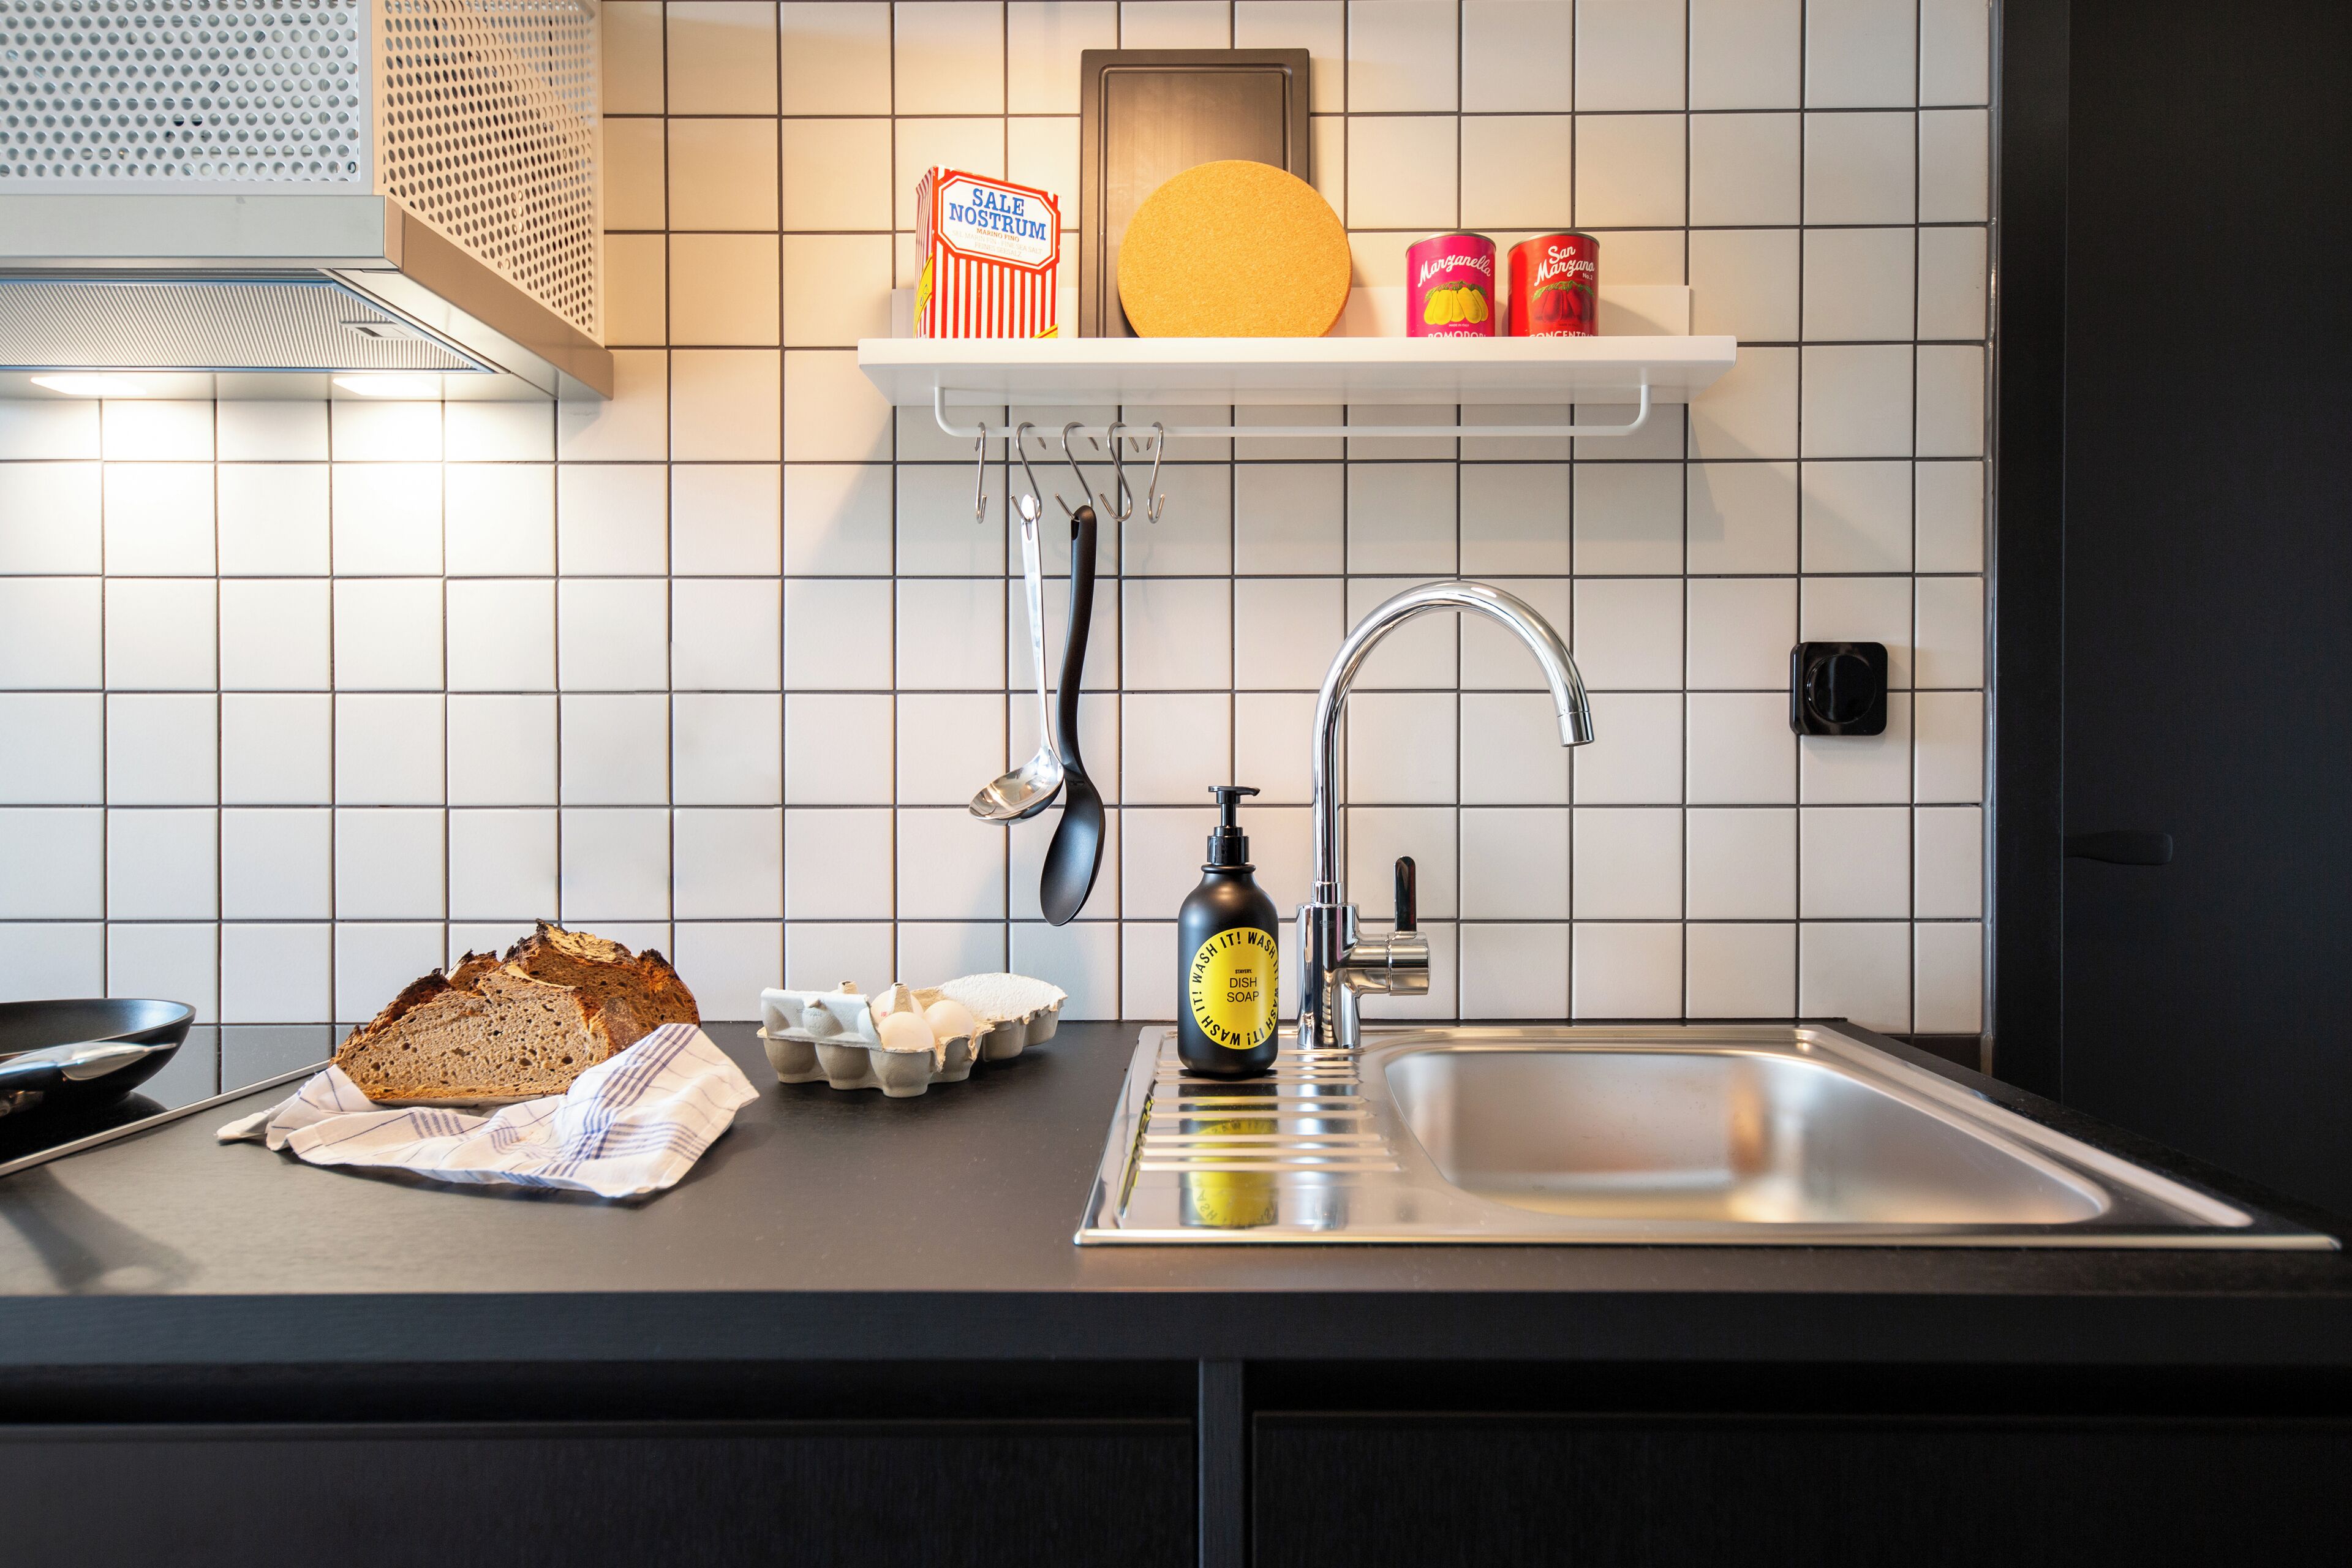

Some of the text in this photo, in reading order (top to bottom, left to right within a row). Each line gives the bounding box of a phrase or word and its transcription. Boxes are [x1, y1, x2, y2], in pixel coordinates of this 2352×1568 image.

[972, 187, 1024, 217] SALE
[949, 202, 1046, 241] NOSTRUM
[976, 228, 1020, 243] MARINO FINO
[1017, 243, 1027, 251] SEA
[1028, 246, 1042, 255] SALT
[1548, 245, 1576, 264] San
[1417, 254, 1491, 287] Marzanella
[1534, 259, 1595, 287] Marzano
[1582, 272, 1593, 281] No.2
[1219, 931, 1241, 948] IT!
[1248, 931, 1276, 959] WASH
[1192, 943, 1218, 983] WASH
[1229, 977, 1257, 988] DISH
[1192, 991, 1205, 1012] IT!
[1226, 991, 1259, 1003] SOAP
[1265, 987, 1278, 1031] WASH
[1201, 1015, 1240, 1046] WASH
[1246, 1028, 1265, 1046] IT!
